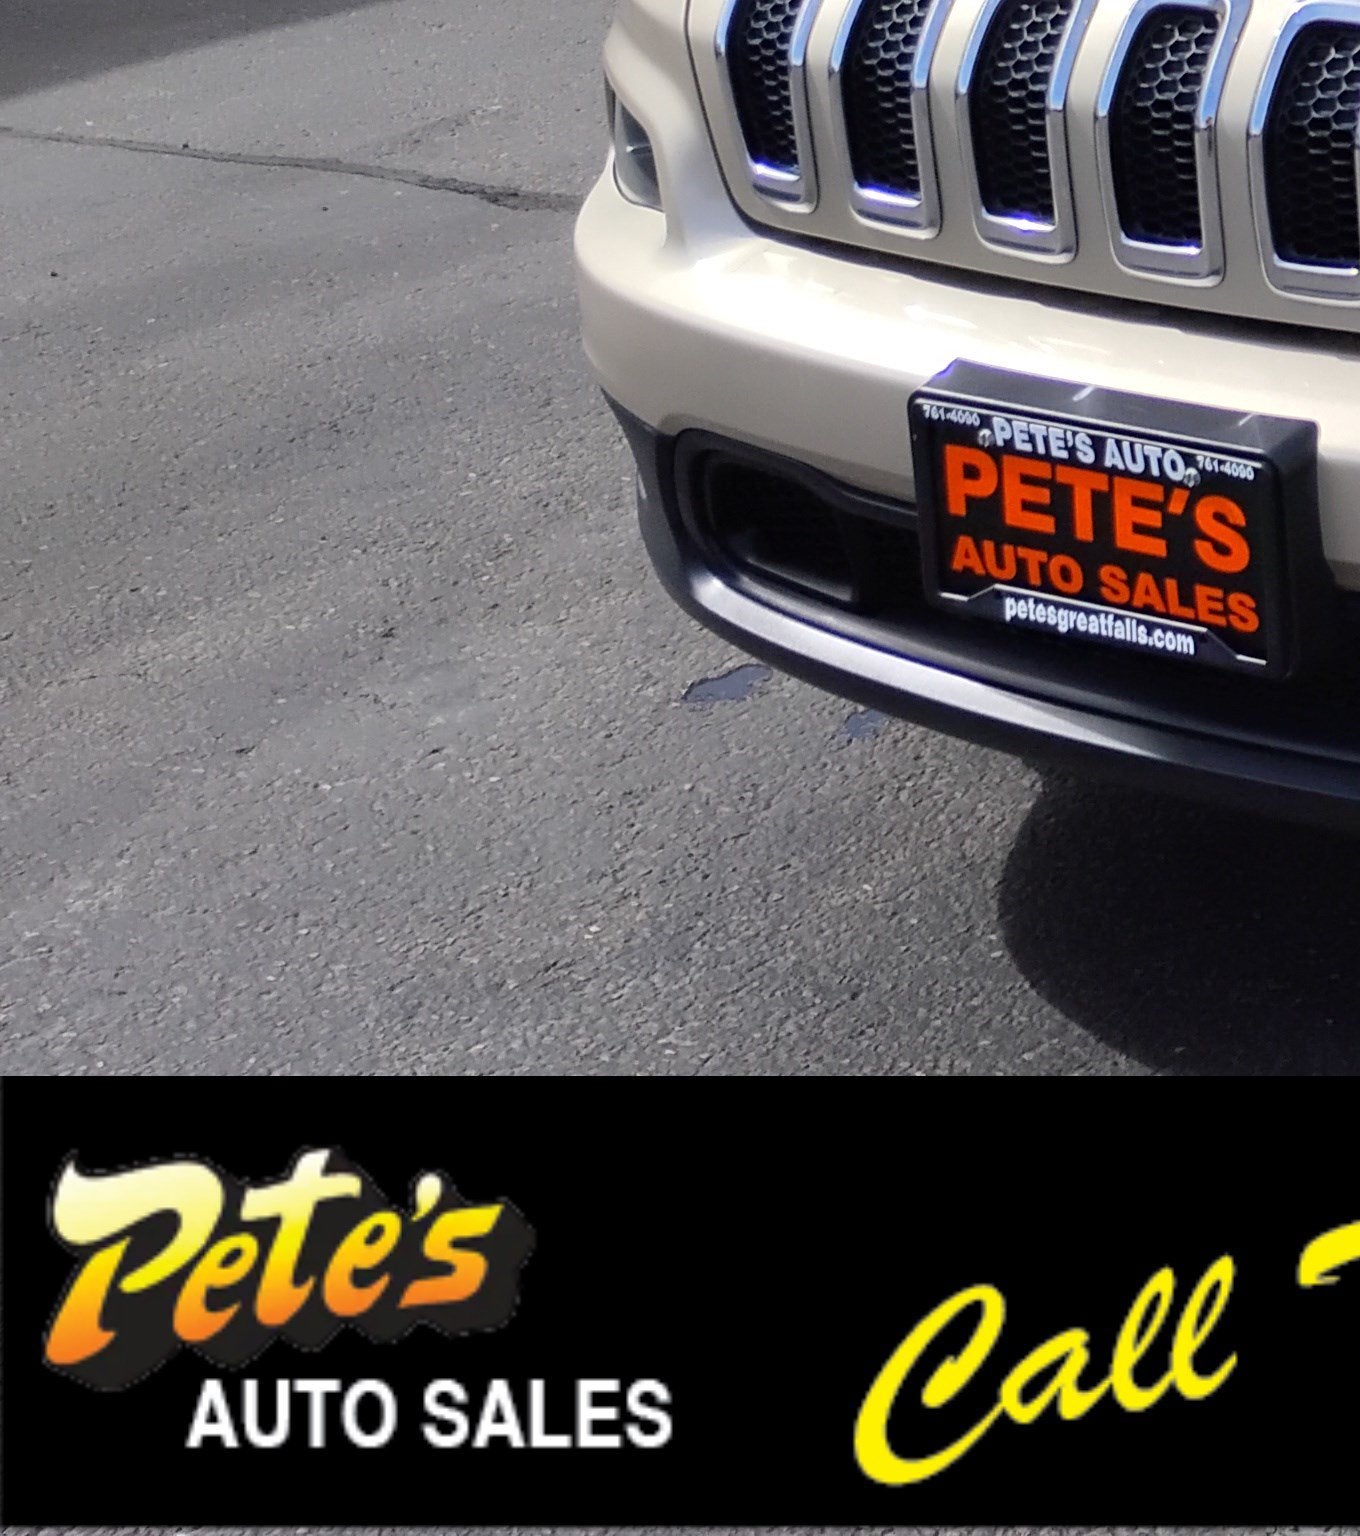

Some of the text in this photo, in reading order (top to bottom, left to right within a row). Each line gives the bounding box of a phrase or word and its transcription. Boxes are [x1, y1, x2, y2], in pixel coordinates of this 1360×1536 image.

[992, 415, 1187, 482] PETE'S AUTO
[945, 444, 1251, 574] PETE'S
[952, 535, 1260, 633] AUTO SALES
[1004, 596, 1195, 655] petesgreatfalls.com
